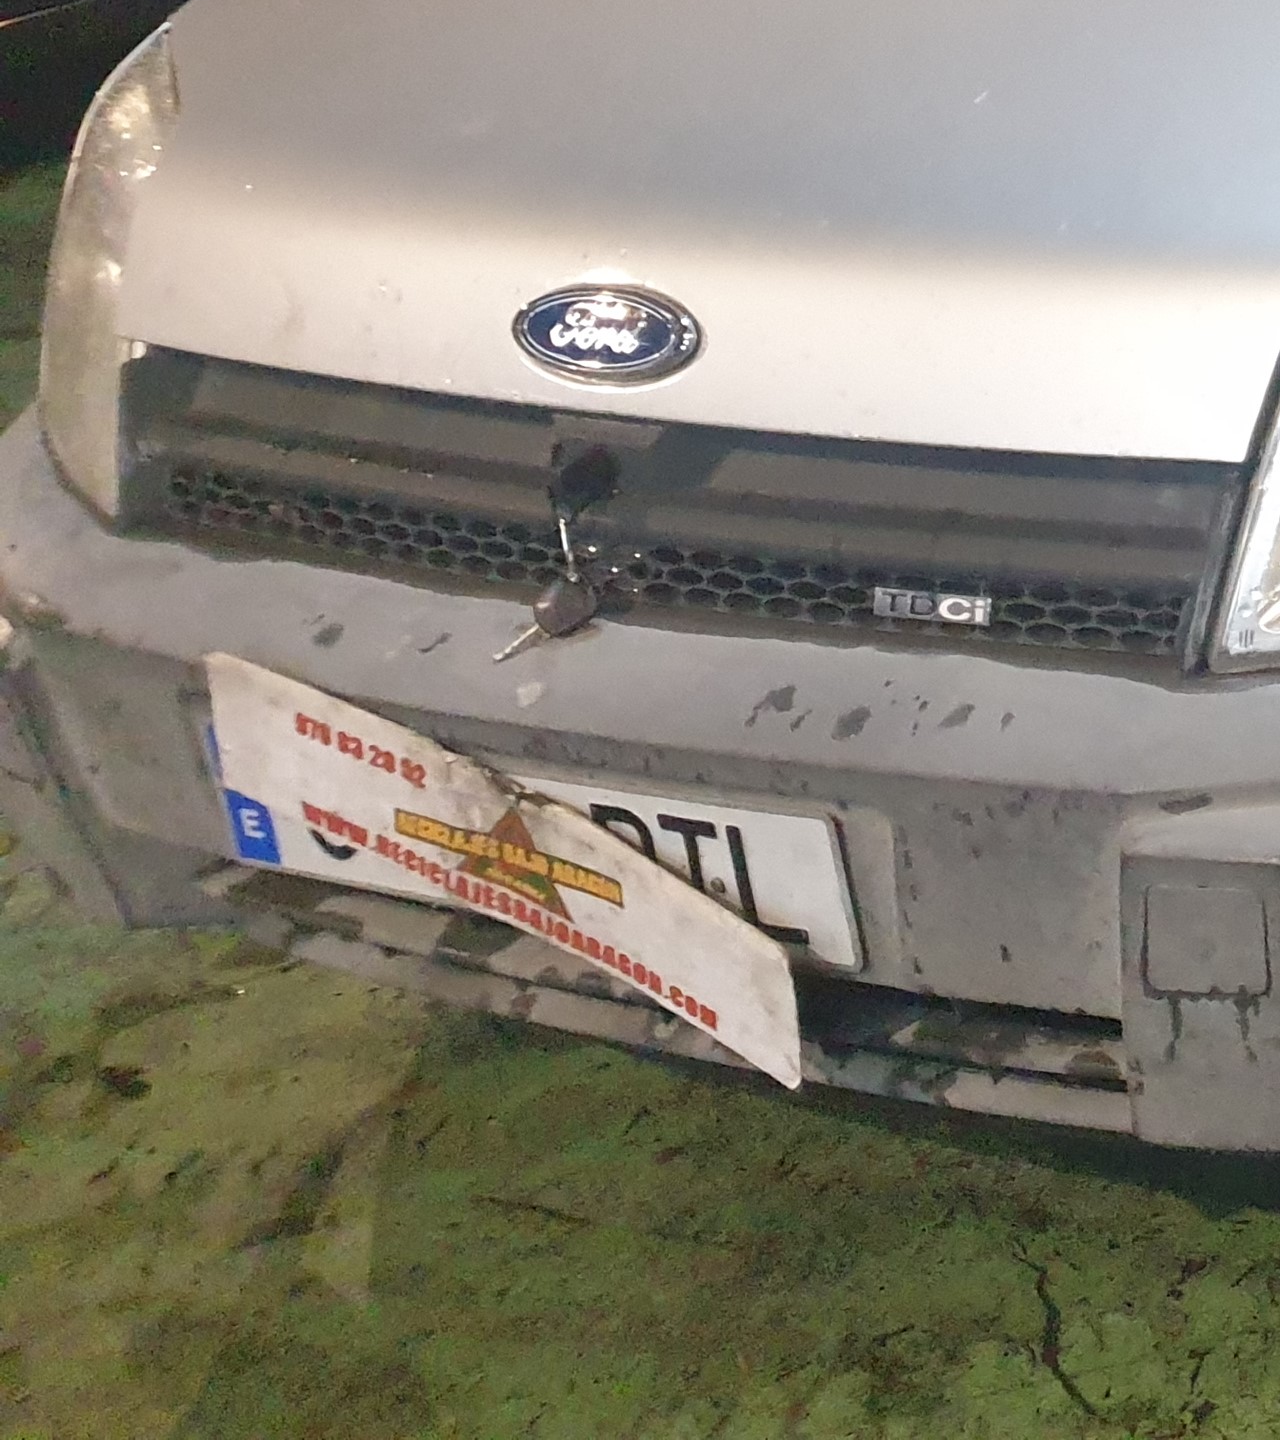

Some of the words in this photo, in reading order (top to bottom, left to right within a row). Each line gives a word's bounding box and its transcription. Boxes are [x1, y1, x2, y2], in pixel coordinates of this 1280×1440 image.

[548, 301, 640, 354] Ford
[880, 590, 986, 623] TDCi
[238, 808, 267, 840] E
